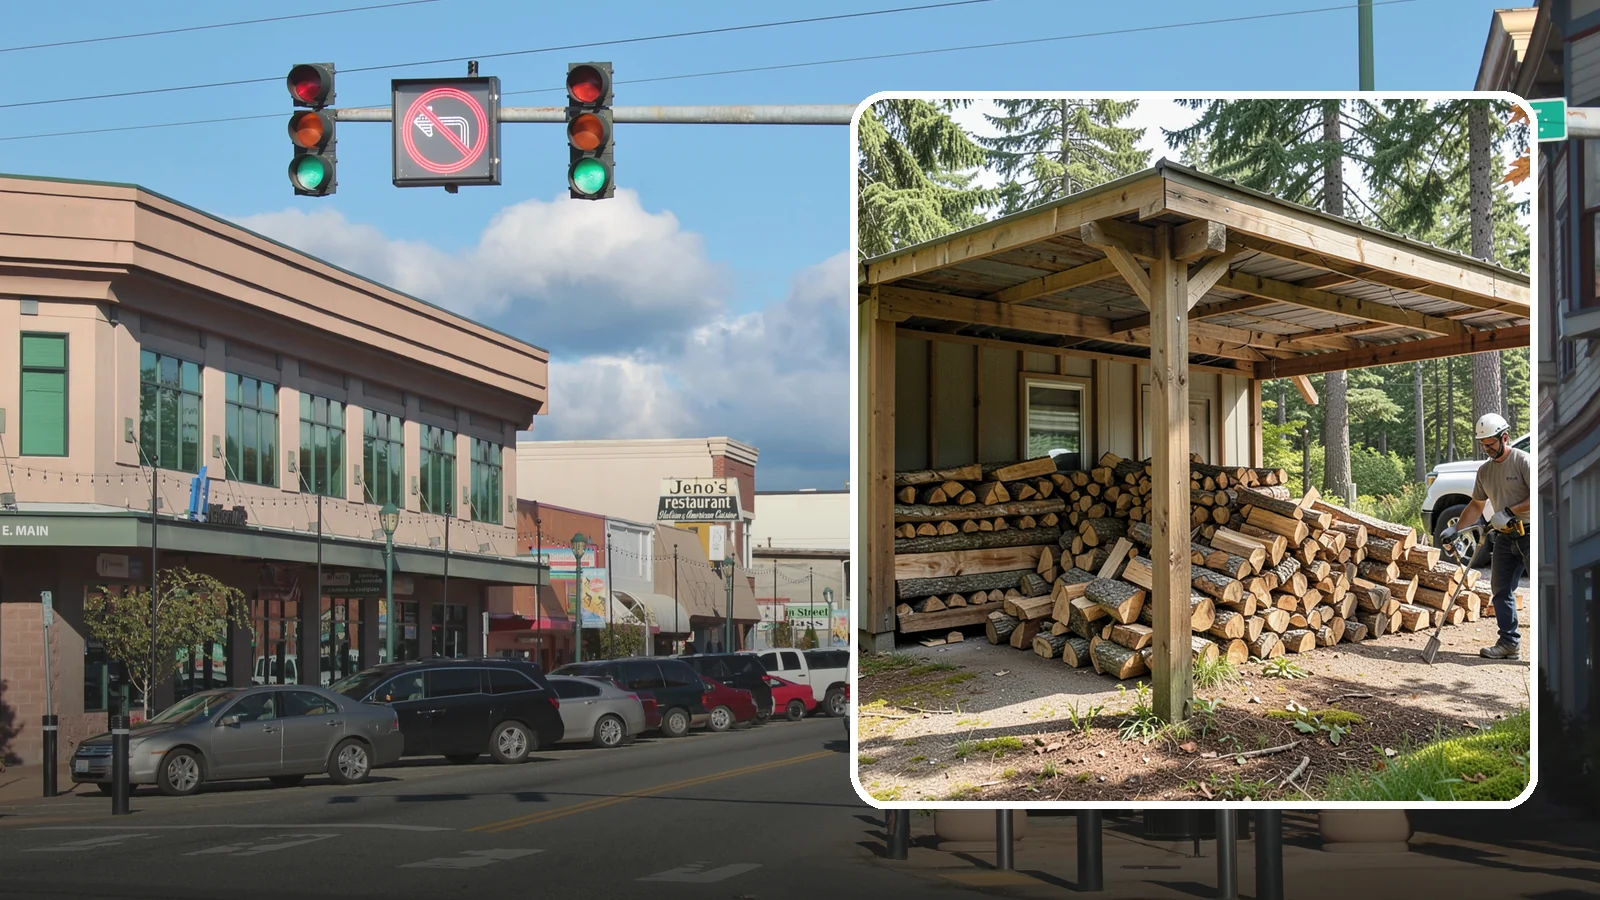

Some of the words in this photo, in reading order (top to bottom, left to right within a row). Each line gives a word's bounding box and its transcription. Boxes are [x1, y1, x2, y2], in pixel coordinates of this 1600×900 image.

[670, 480, 727, 494] Jeno's
[665, 496, 731, 509] restaurant
[659, 510, 681, 519] Italian
[686, 510, 714, 519] American
[715, 509, 737, 519] Cuisine
[2, 525, 13, 536] E.
[15, 525, 49, 536] MAIN
[798, 608, 828, 617] Street
